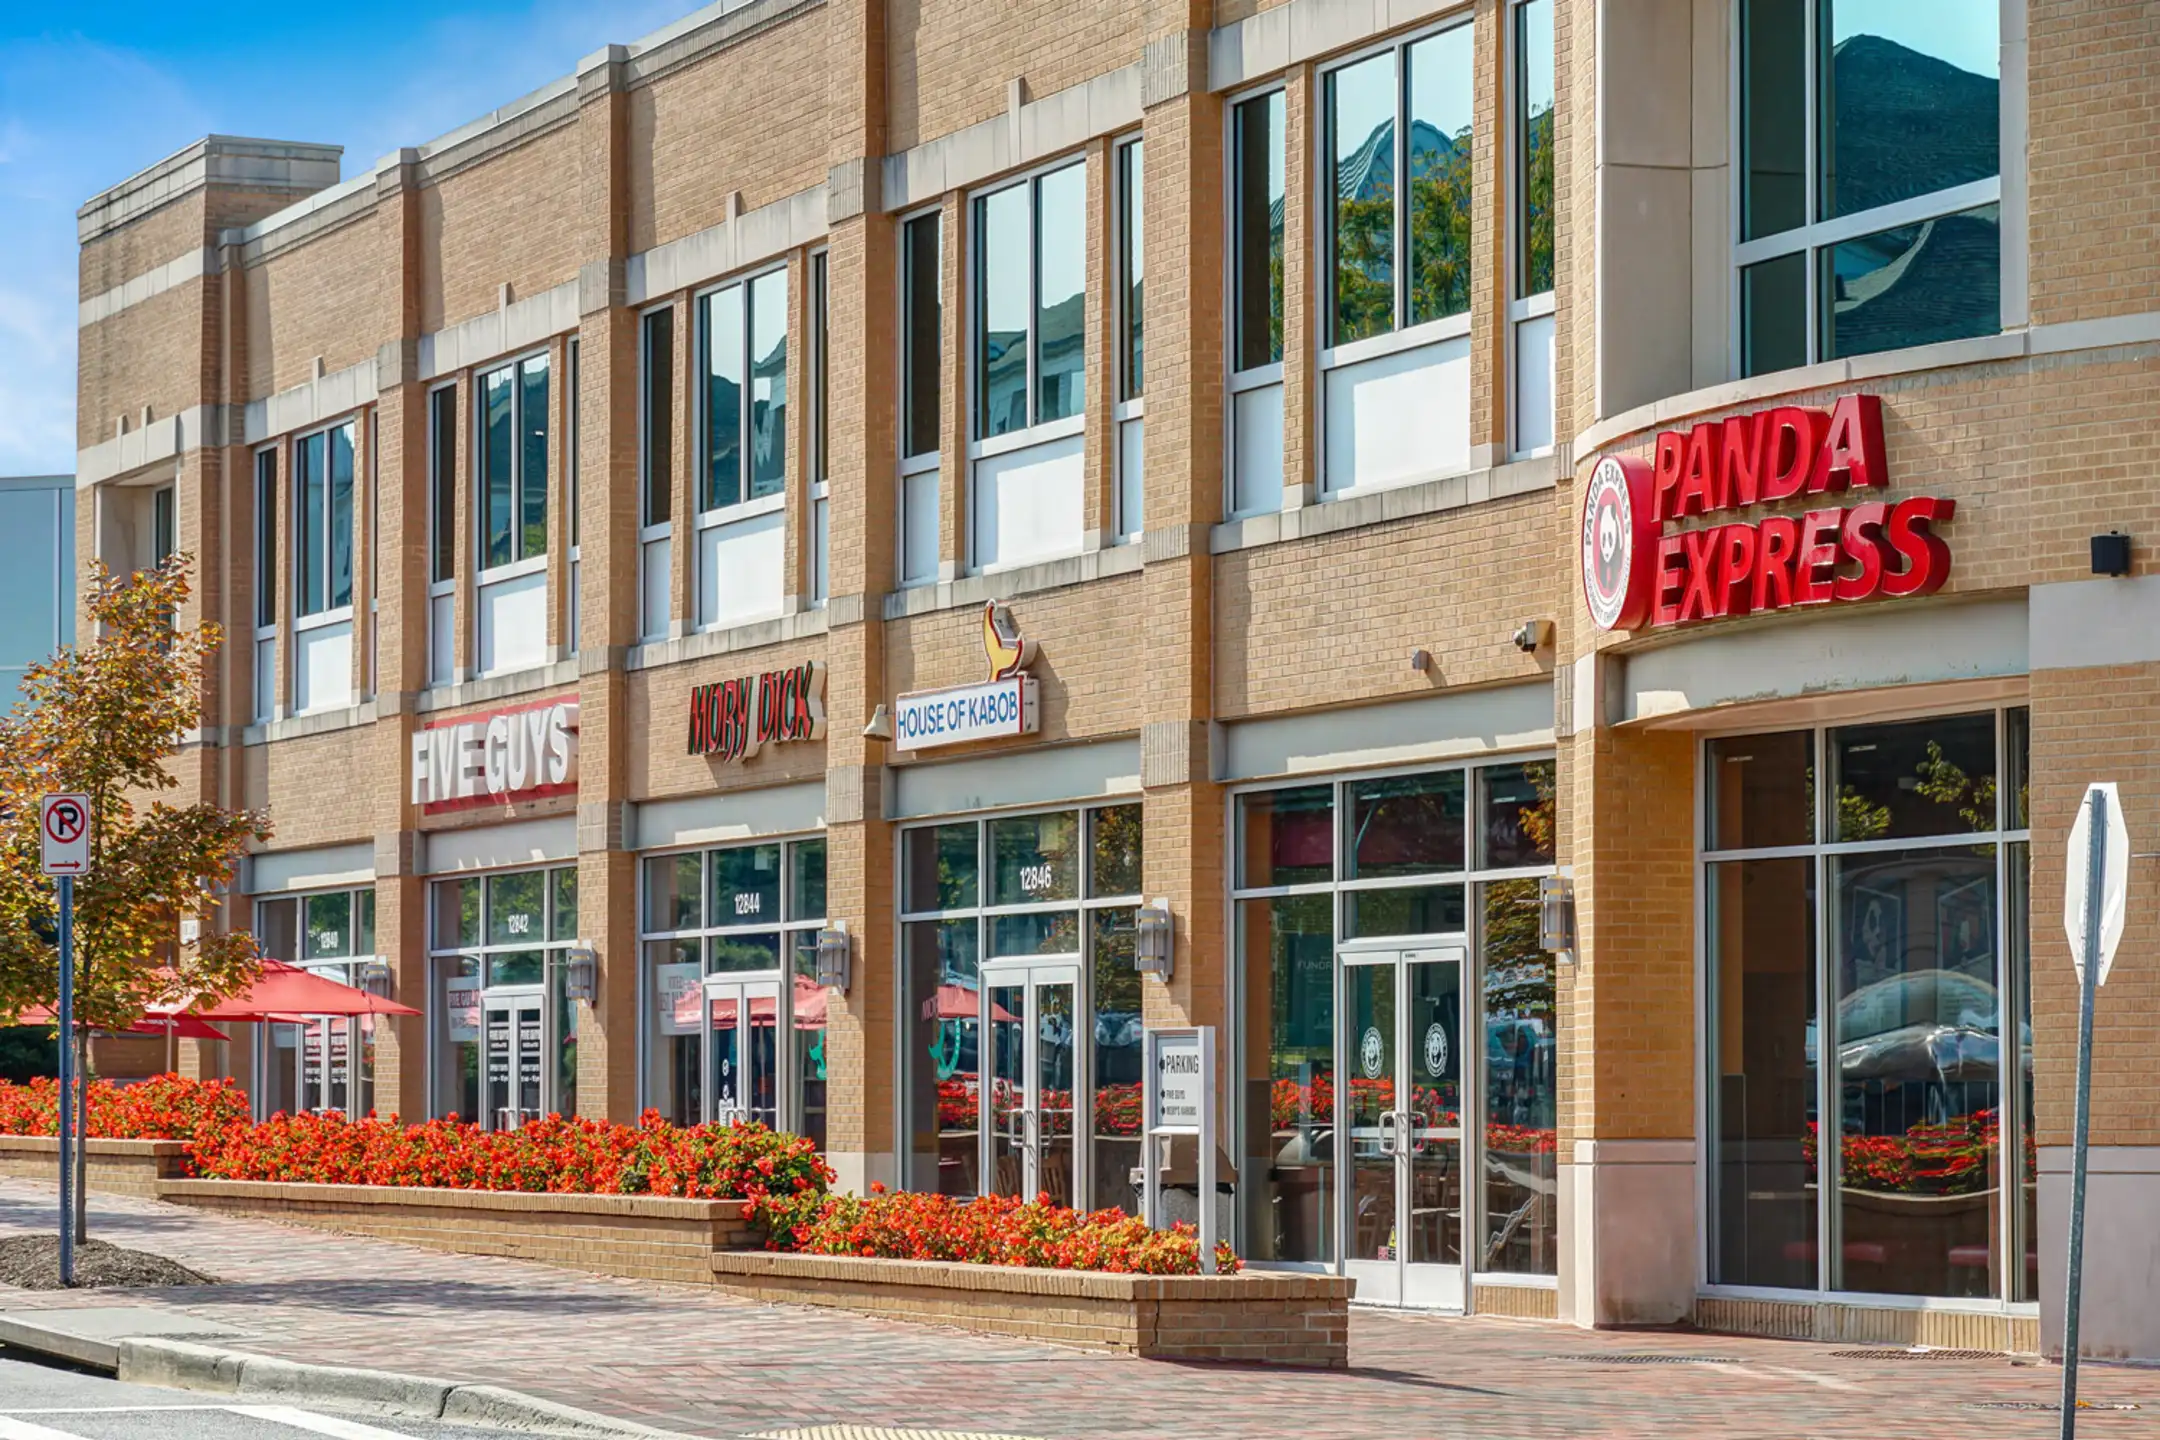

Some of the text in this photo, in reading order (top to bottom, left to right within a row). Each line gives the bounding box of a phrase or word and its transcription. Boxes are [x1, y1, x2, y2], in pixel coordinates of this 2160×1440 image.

[1652, 394, 1886, 523] PANDA
[1585, 471, 1604, 546] PANDA
[1651, 496, 1954, 627] EXPRESS
[688, 661, 818, 764] MOBY DICK
[897, 690, 1019, 739] HOUSE OF KABOB
[411, 703, 571, 805] FIVE GUYS
[58, 806, 78, 836] P
[735, 892, 760, 915] 12844
[1020, 865, 1052, 890] 12846
[1166, 1054, 1199, 1074] PARKING
